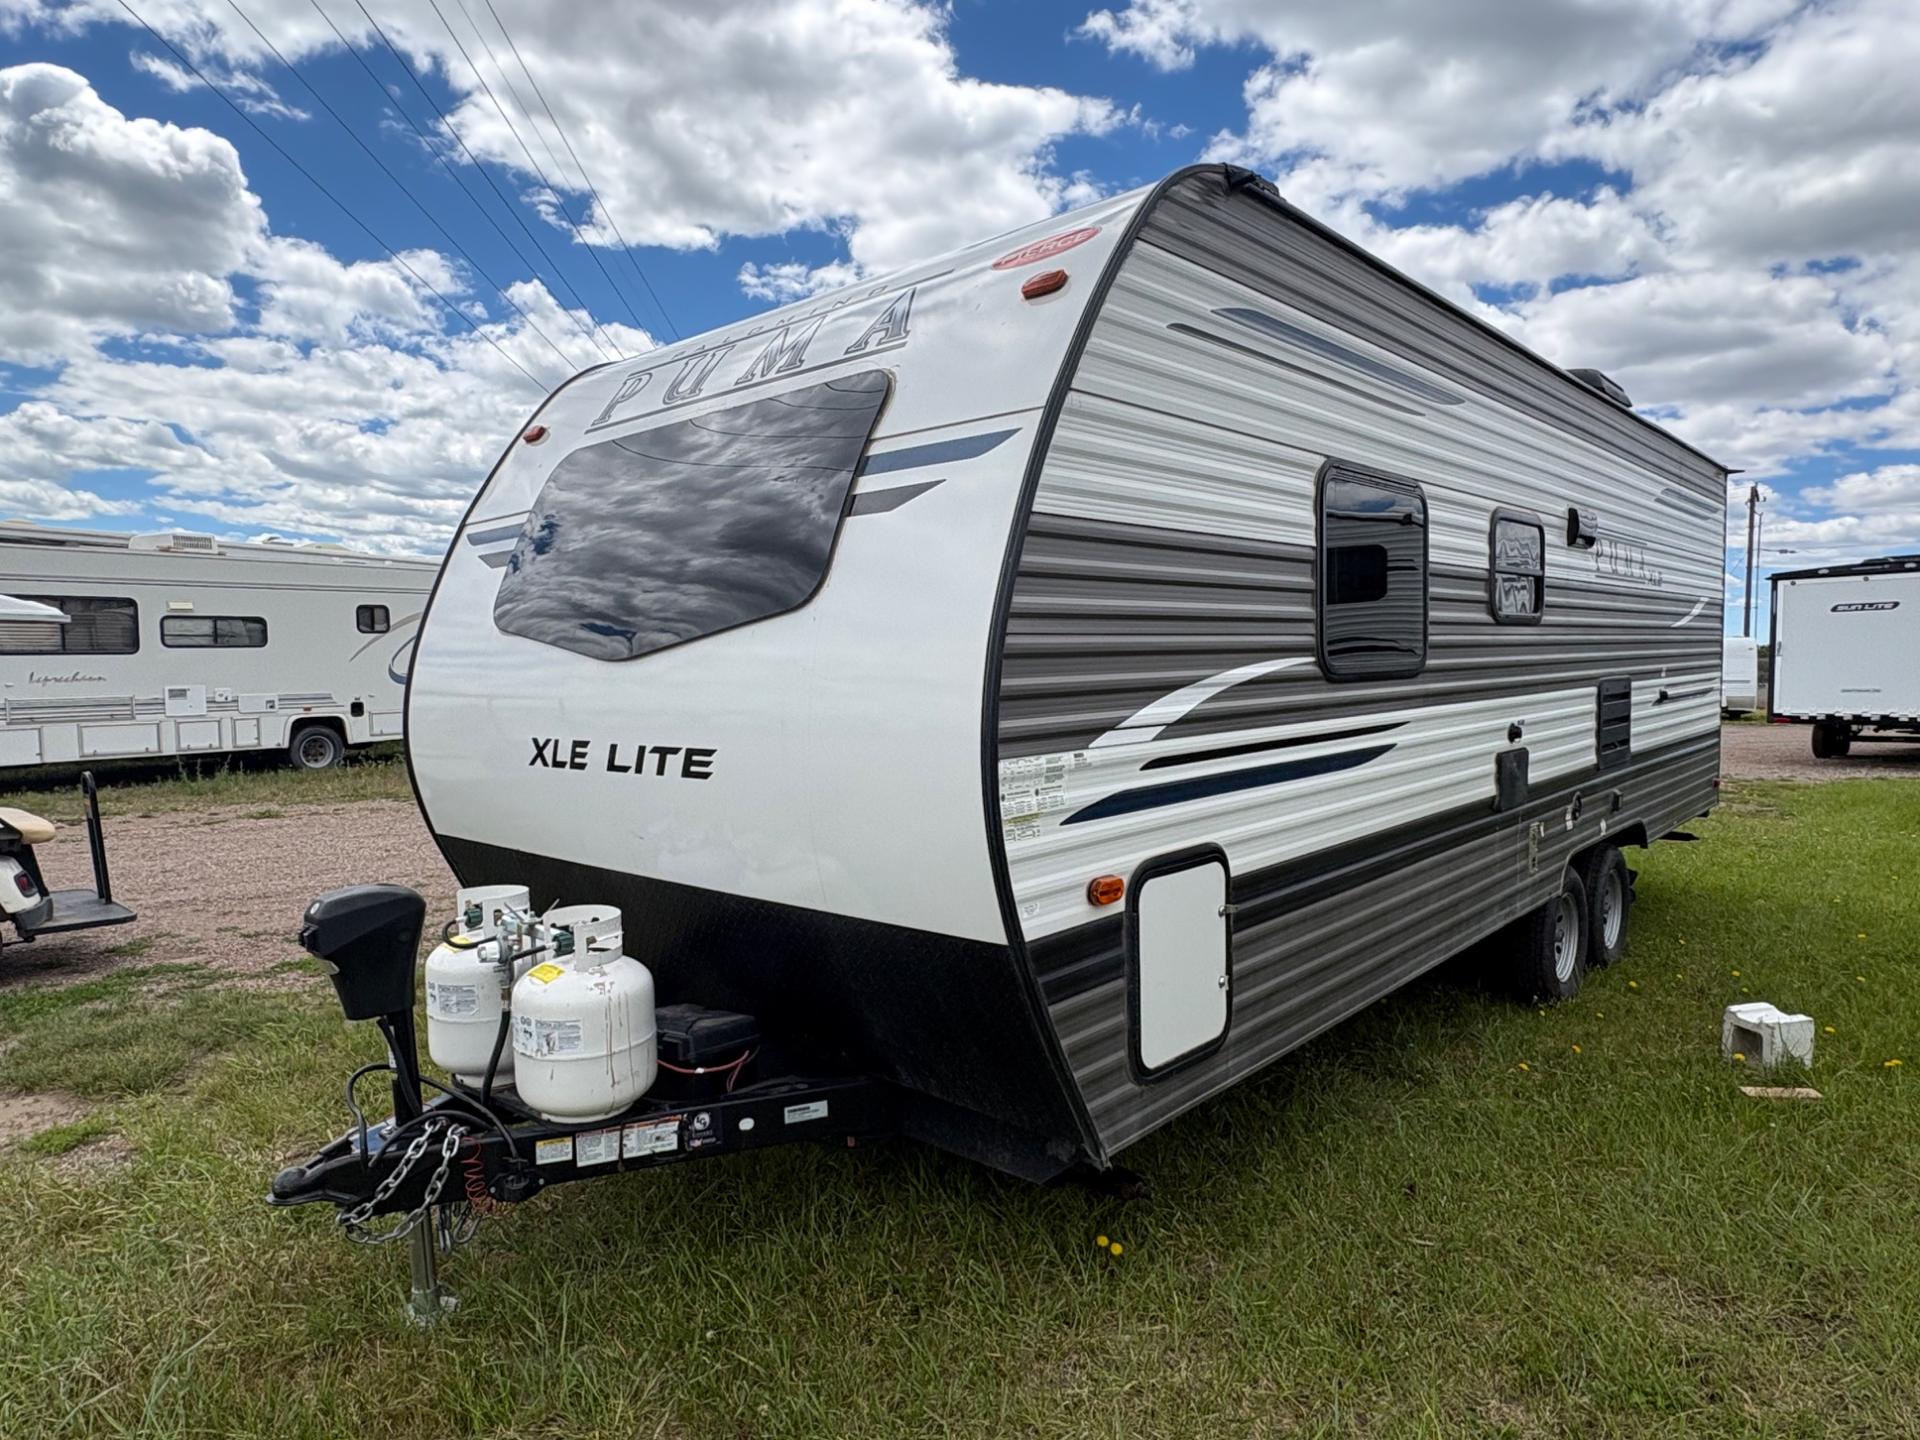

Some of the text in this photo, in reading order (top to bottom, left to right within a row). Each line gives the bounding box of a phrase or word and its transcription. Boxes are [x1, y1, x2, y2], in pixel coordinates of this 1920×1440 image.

[590, 286, 917, 426] PUMA
[528, 737, 718, 780] XLE LITE
